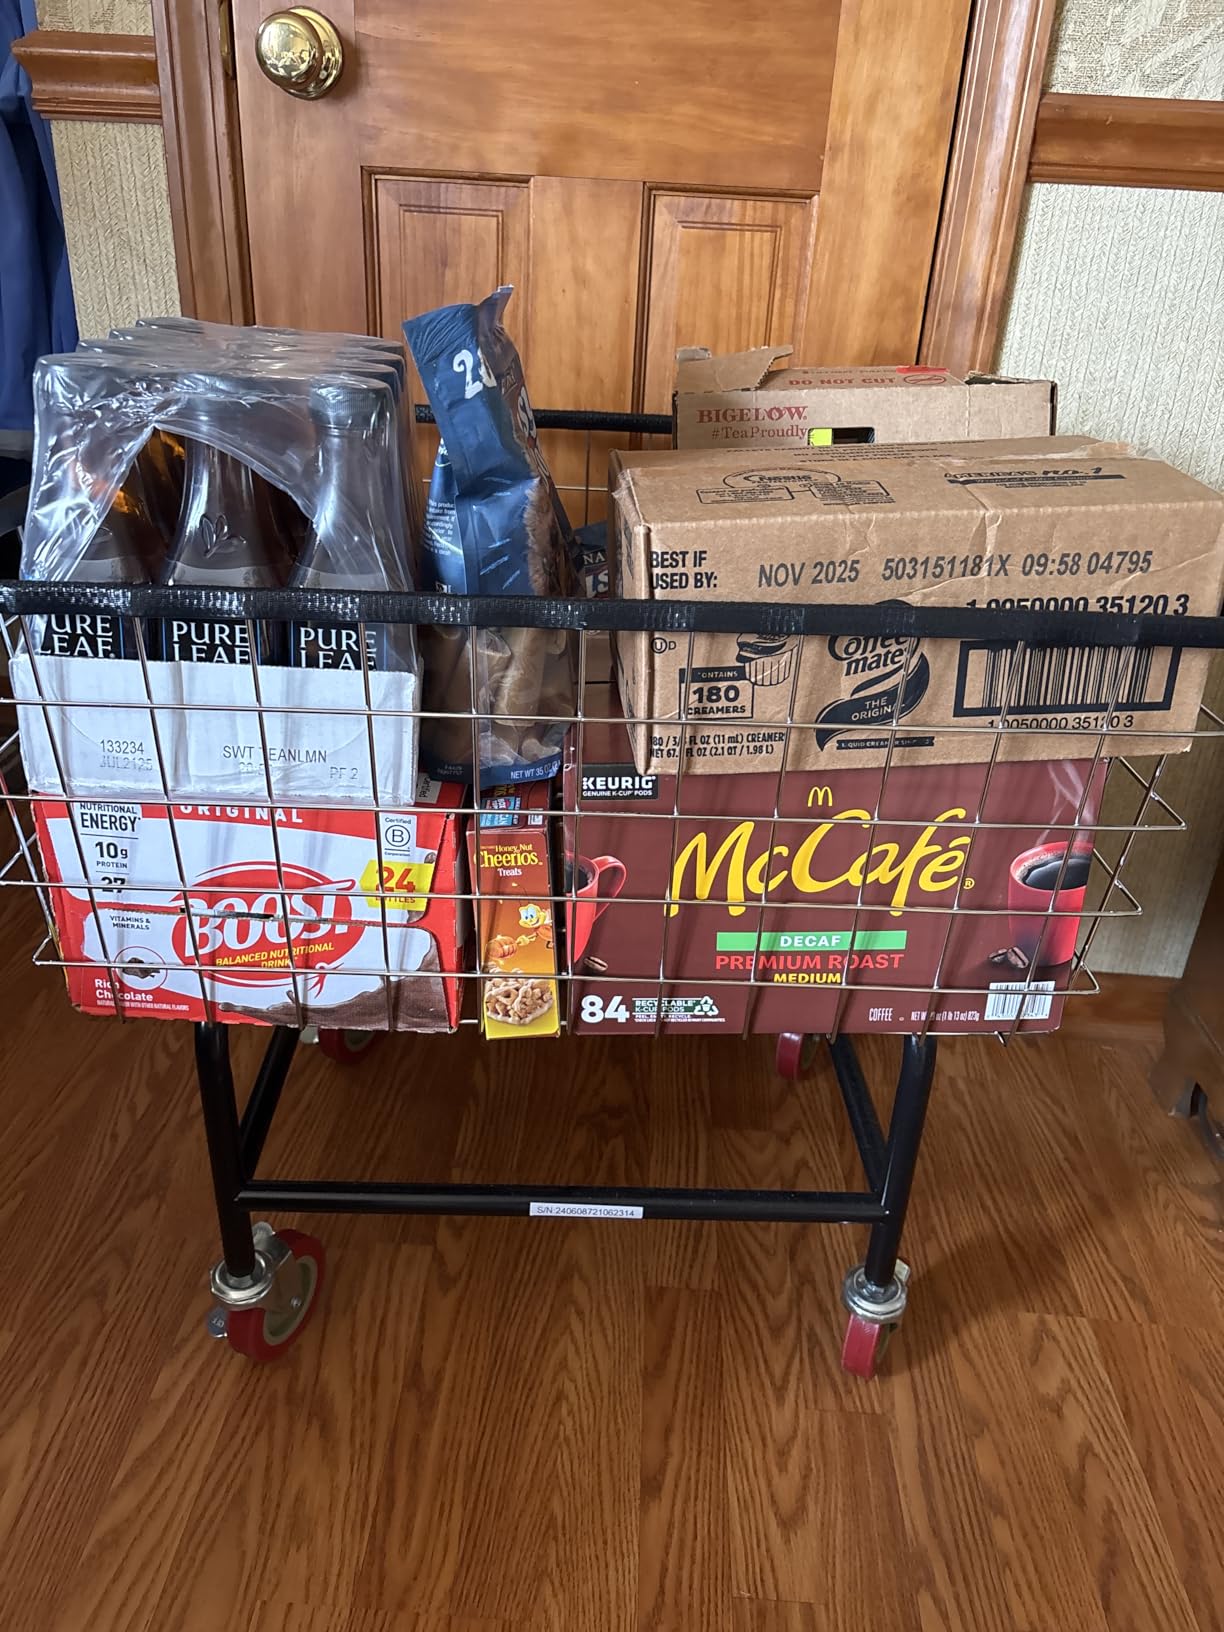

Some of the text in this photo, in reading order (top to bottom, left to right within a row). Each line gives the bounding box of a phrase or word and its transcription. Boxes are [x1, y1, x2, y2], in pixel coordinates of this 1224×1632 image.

[696, 405, 808, 424] BIGELOW
[711, 425, 808, 441] #TeaProudly
[651, 550, 707, 568] BEST IF
[758, 550, 1153, 588] NOV 2025 503151181X 09:58 04795
[650, 571, 718, 589] USED BY:
[1095, 595, 1168, 616] 35120
[1173, 593, 1190, 617] 3
[50, 614, 113, 637] URE
[172, 620, 250, 646] PURE
[299, 627, 378, 653] PURE
[845, 646, 908, 677] mate
[692, 684, 740, 704] 180
[687, 705, 746, 715] CREAMERS
[865, 697, 888, 710] THE
[851, 704, 906, 721] ORIGIN
[1124, 714, 1134, 728] 3
[100, 739, 145, 755] 133234
[672, 735, 687, 747] 3/
[701, 734, 710, 745] OZ
[222, 745, 328, 763] SWT EANLMN
[666, 747, 681, 758] 67.
[697, 746, 708, 756] OZ
[710, 746, 725, 757] (2.1
[350, 767, 359, 780] 2
[510, 770, 524, 779] NET
[524, 768, 535, 778] WT
[535, 766, 544, 776] 35
[582, 775, 654, 790] KEURIG
[80, 802, 138, 815] NUTRITIONAL
[80, 812, 138, 833] ENERGY
[384, 817, 412, 825] Certified
[95, 841, 128, 859] 10g
[495, 845, 518, 853] Honey
[519, 844, 533, 852] Nut
[96, 860, 128, 869] PROTEIN
[664, 808, 971, 917] McCafé
[376, 866, 416, 893] 24
[497, 867, 522, 877] Treats
[101, 876, 126, 893] 27
[376, 896, 416, 904] TTLES
[110, 915, 144, 924] VITAMINS
[112, 922, 150, 931] MINERALS
[184, 880, 356, 958] BOOST
[780, 934, 841, 948] DECAF
[216, 942, 335, 967] BALANCED NUTRITIONAL
[716, 953, 905, 971] PREMIUM ROAST
[773, 972, 842, 984] MEDIUM
[96, 989, 153, 1002] Chcolate
[580, 994, 630, 1024] 84
[868, 1007, 893, 1022] COFFEE
